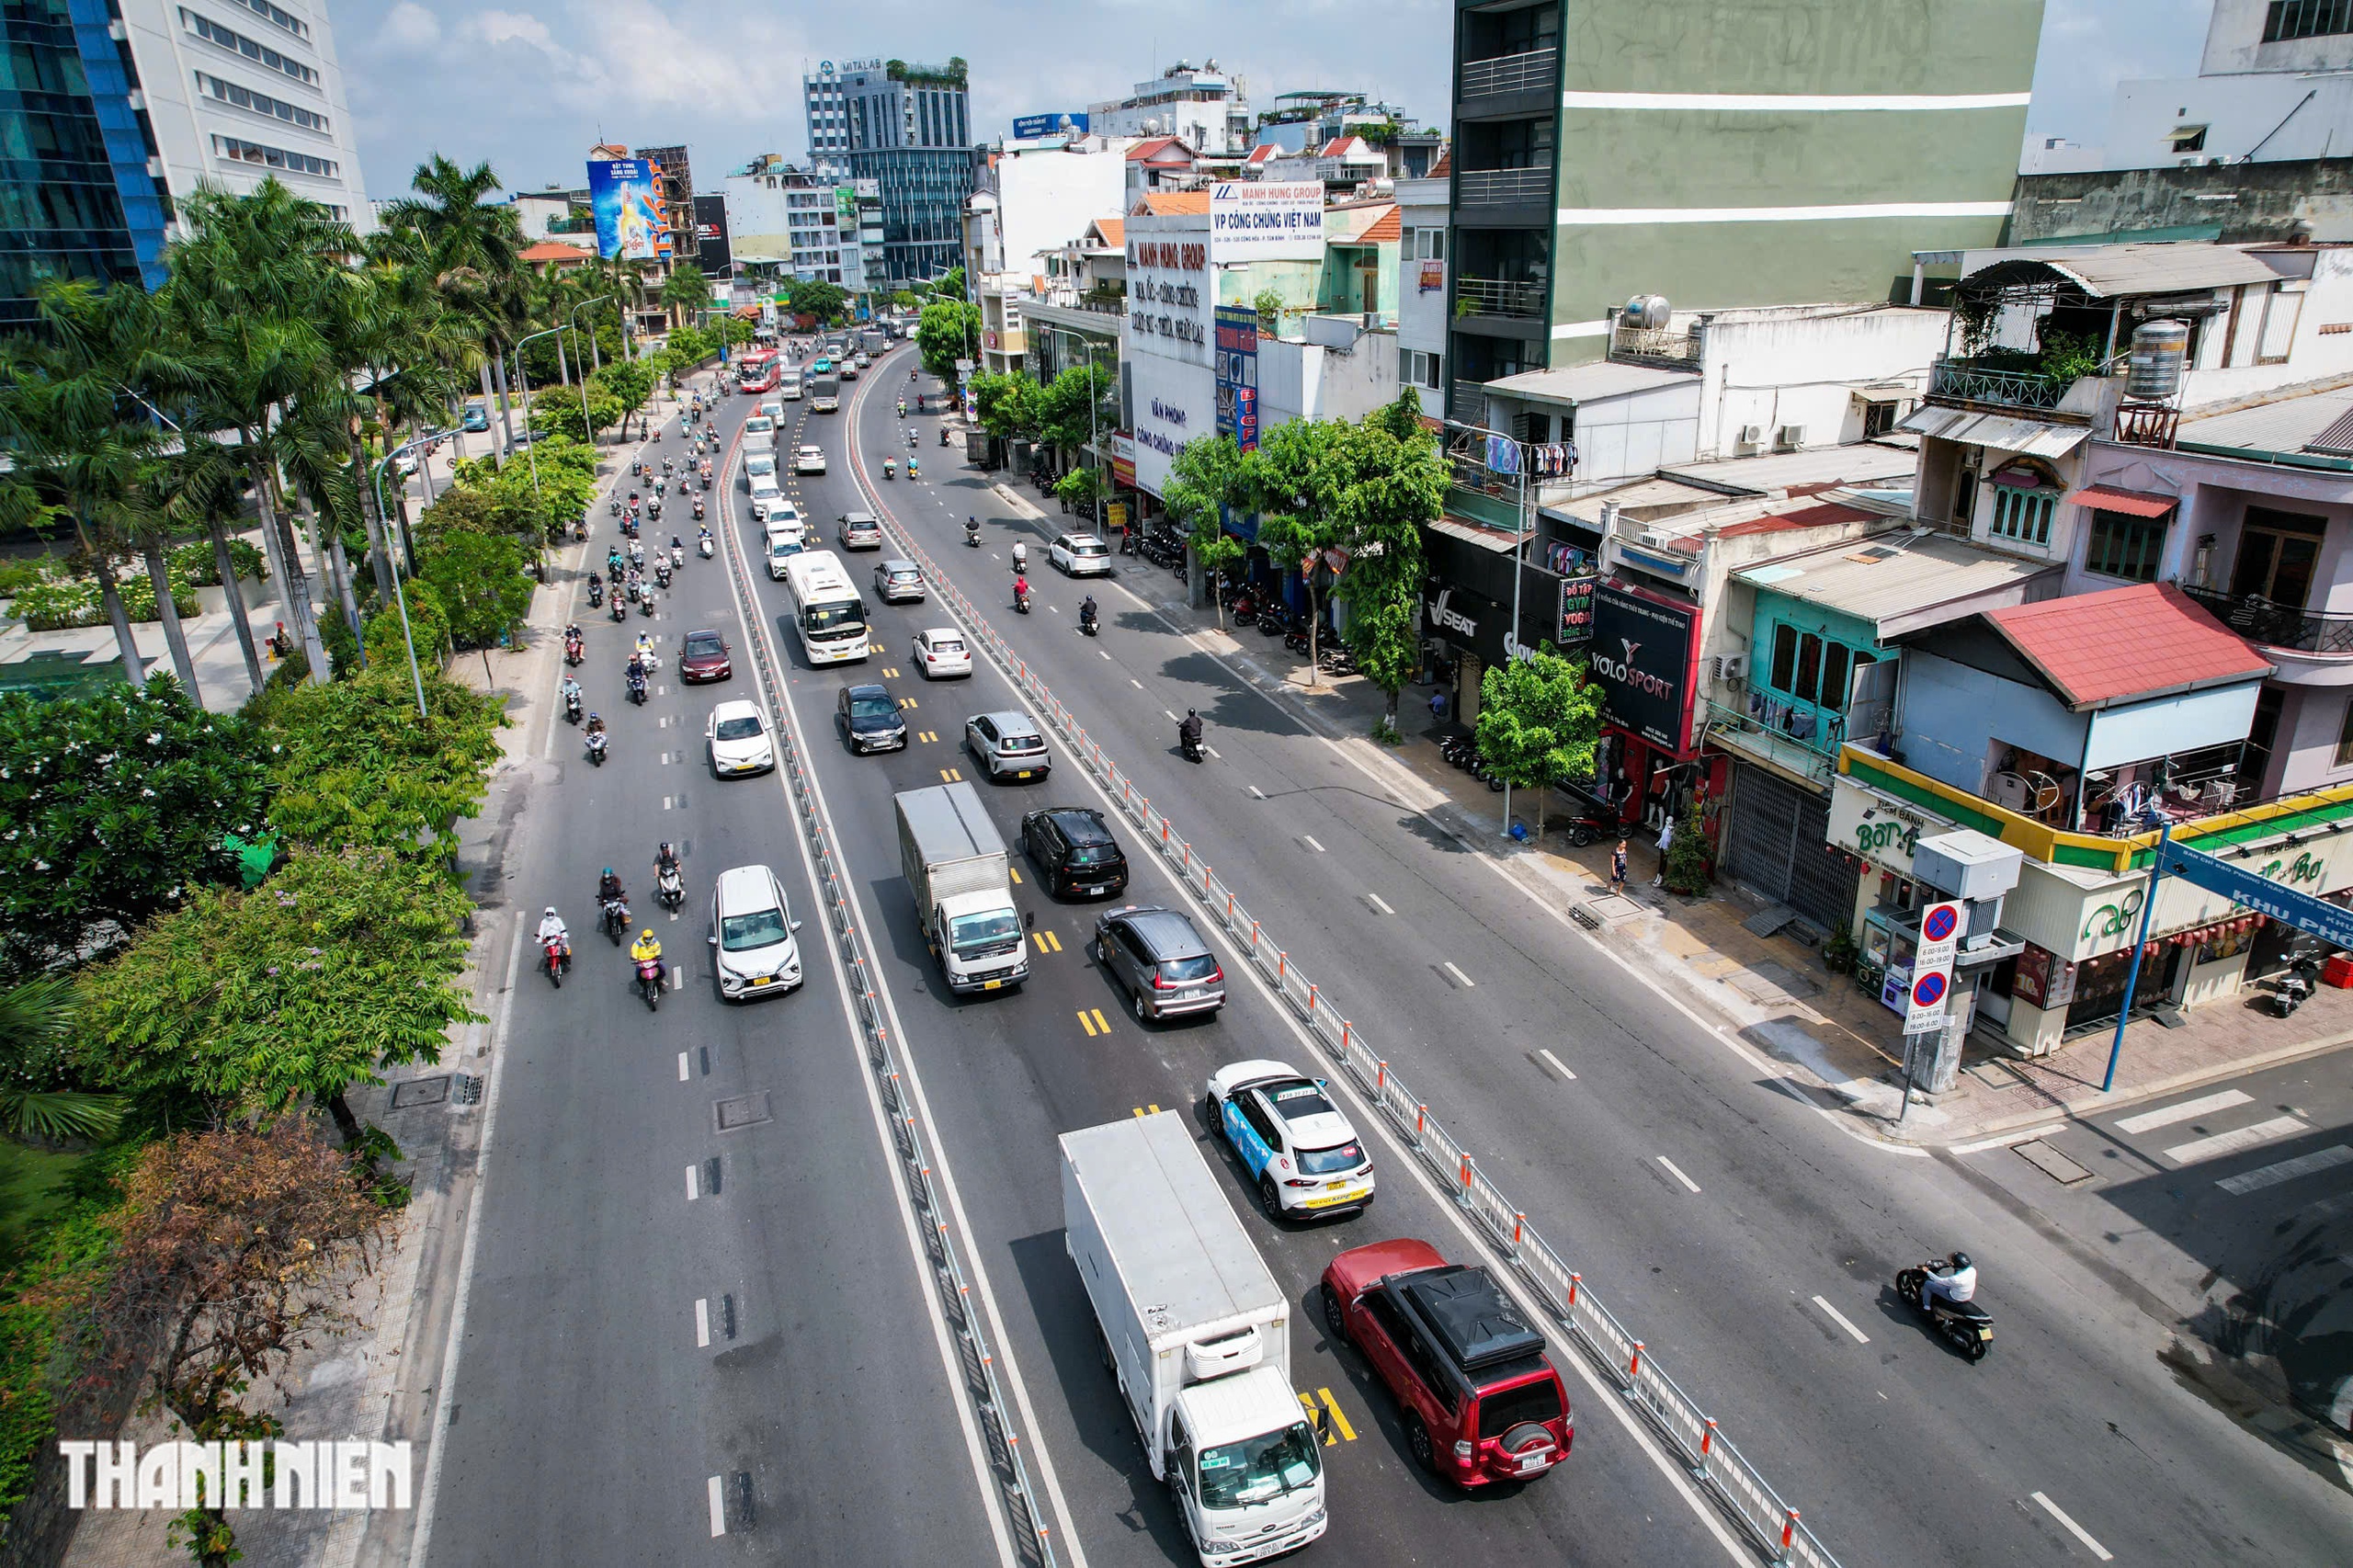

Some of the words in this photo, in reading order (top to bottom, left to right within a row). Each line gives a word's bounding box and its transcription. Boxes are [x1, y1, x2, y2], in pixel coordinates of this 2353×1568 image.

[843, 59, 881, 72] MITALAB
[1243, 187, 1266, 199] MANH
[1268, 187, 1290, 199] HUNG
[1294, 187, 1322, 199] GROUP
[1215, 213, 1226, 230] VP
[1229, 210, 1250, 229] CÔNG
[1254, 208, 1281, 229] CHỨNG
[1283, 208, 1302, 233] VIỆT
[1304, 211, 1321, 228] NAM
[1139, 243, 1158, 268] MANH
[1160, 243, 1180, 268] HUNG
[1181, 243, 1206, 271] GROUP
[1151, 397, 1164, 419] VĂN
[1165, 403, 1187, 425] PHÒNG
[1137, 424, 1153, 447] CÔNG
[1579, 585, 1592, 596] TẬP
[1567, 597, 1590, 609] GYM
[1564, 611, 1590, 625] YOGA
[1592, 653, 1627, 682] YOLO
[1627, 667, 1674, 701] SPORT
[1899, 809, 1925, 828] BÁNH
[1903, 827, 1919, 858] B
[2183, 849, 2199, 858] BAN
[2234, 870, 2260, 884] PHONG
[2317, 904, 2335, 914] DÂN
[2232, 890, 2289, 919] KHU
